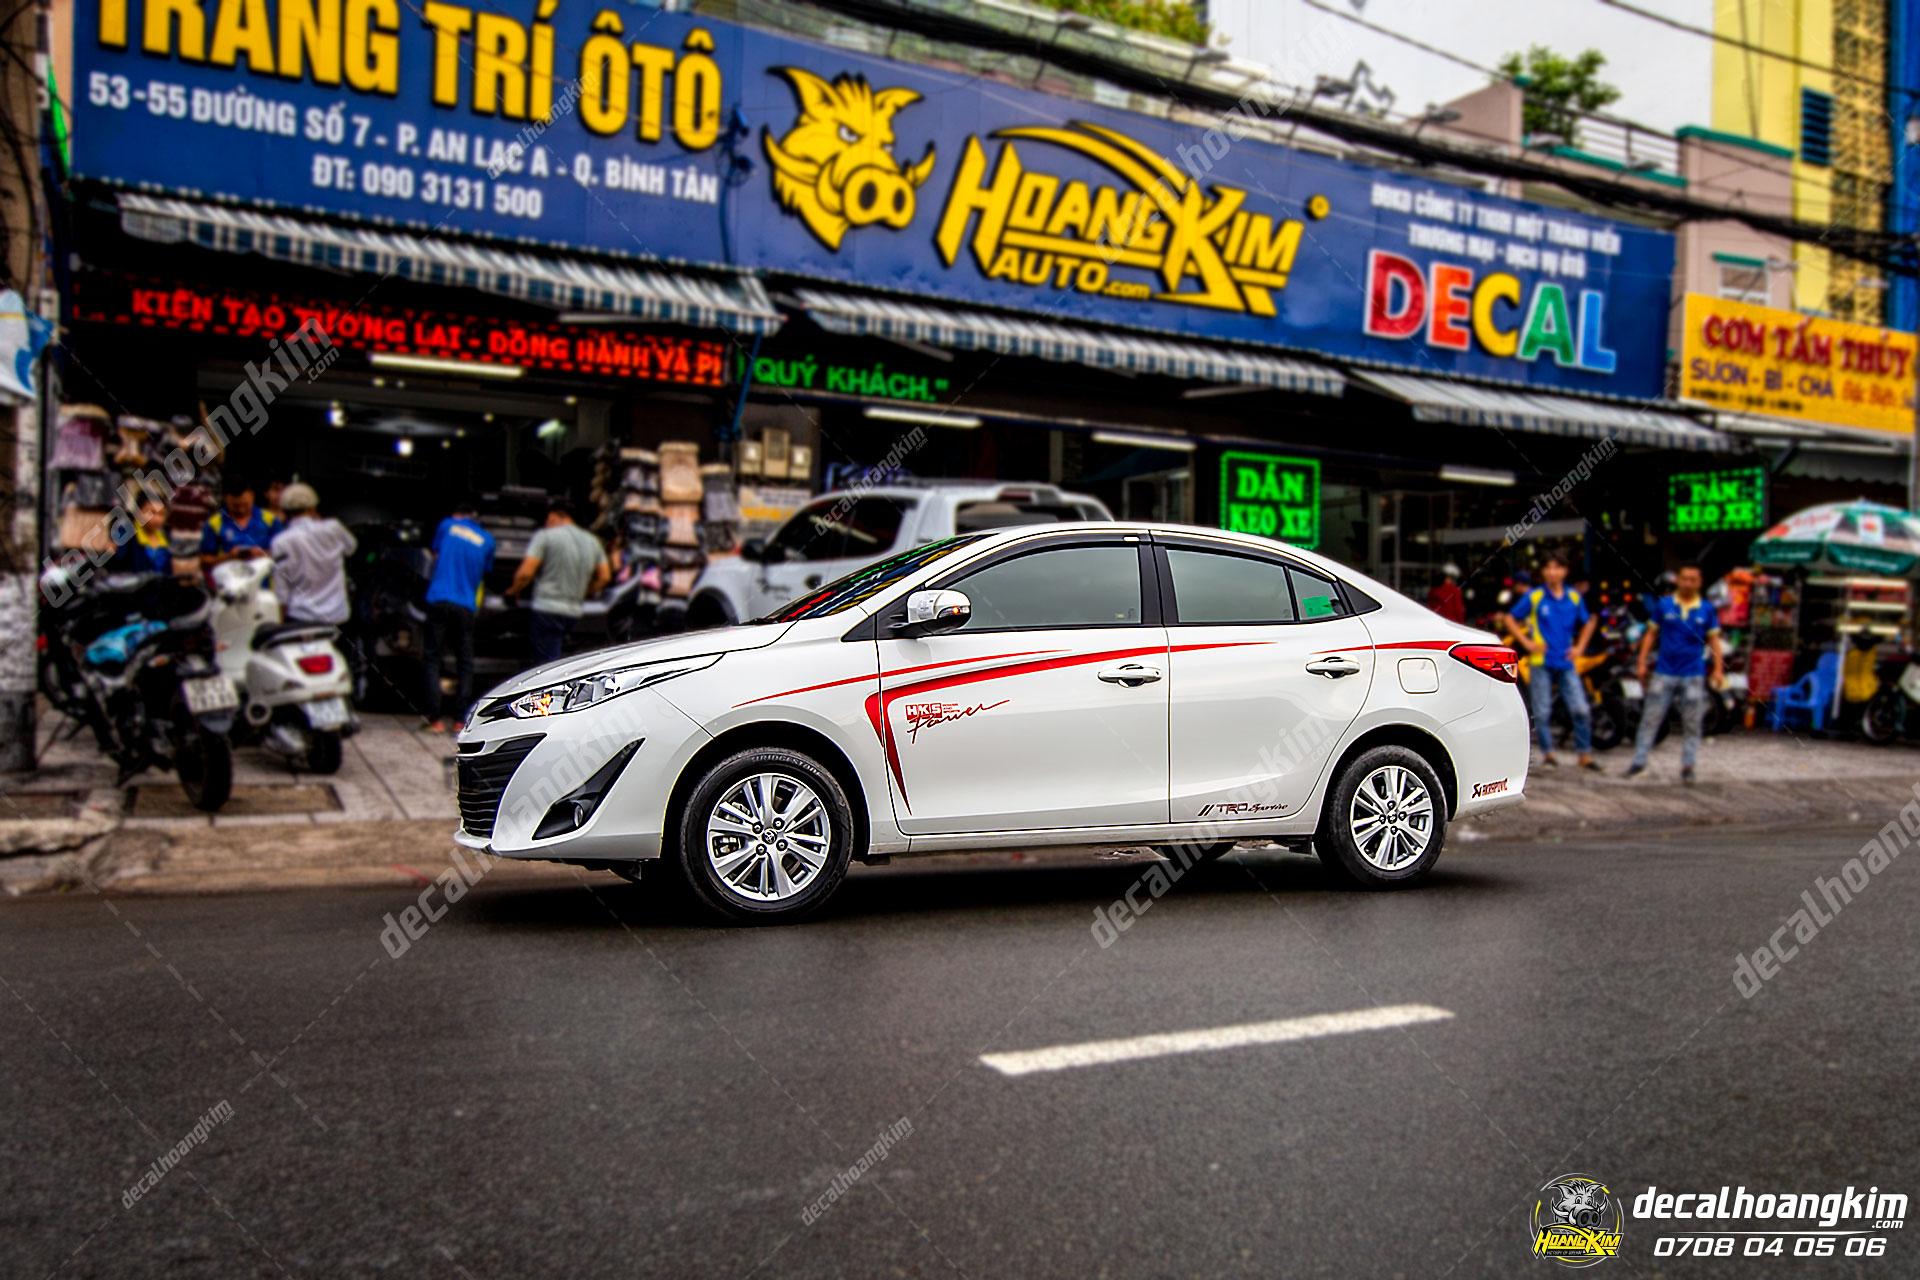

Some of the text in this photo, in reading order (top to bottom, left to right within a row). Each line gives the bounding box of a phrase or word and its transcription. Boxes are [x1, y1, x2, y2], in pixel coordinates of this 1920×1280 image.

[424, 0, 558, 123] TRÍ
[578, 10, 721, 149] ÔTÔ
[88, 71, 187, 119] 53-55
[191, 84, 297, 136] ĐƯỜNG
[304, 102, 346, 145] SỐ
[352, 115, 371, 147] 7
[396, 123, 420, 158] P.
[428, 129, 468, 164] AN
[529, 145, 549, 178] A
[573, 152, 600, 187] Q.
[604, 153, 666, 197] BÌNH
[671, 163, 719, 205] TÂN
[311, 153, 544, 219] ĐT: 090 3131 500
[413, 320, 462, 350] LAI
[1363, 250, 1617, 374] DECAL
[753, 354, 818, 388] QUÝ
[1235, 461, 1305, 503] DÁN
[906, 703, 943, 720] HKS
[907, 699, 1011, 745] Power
